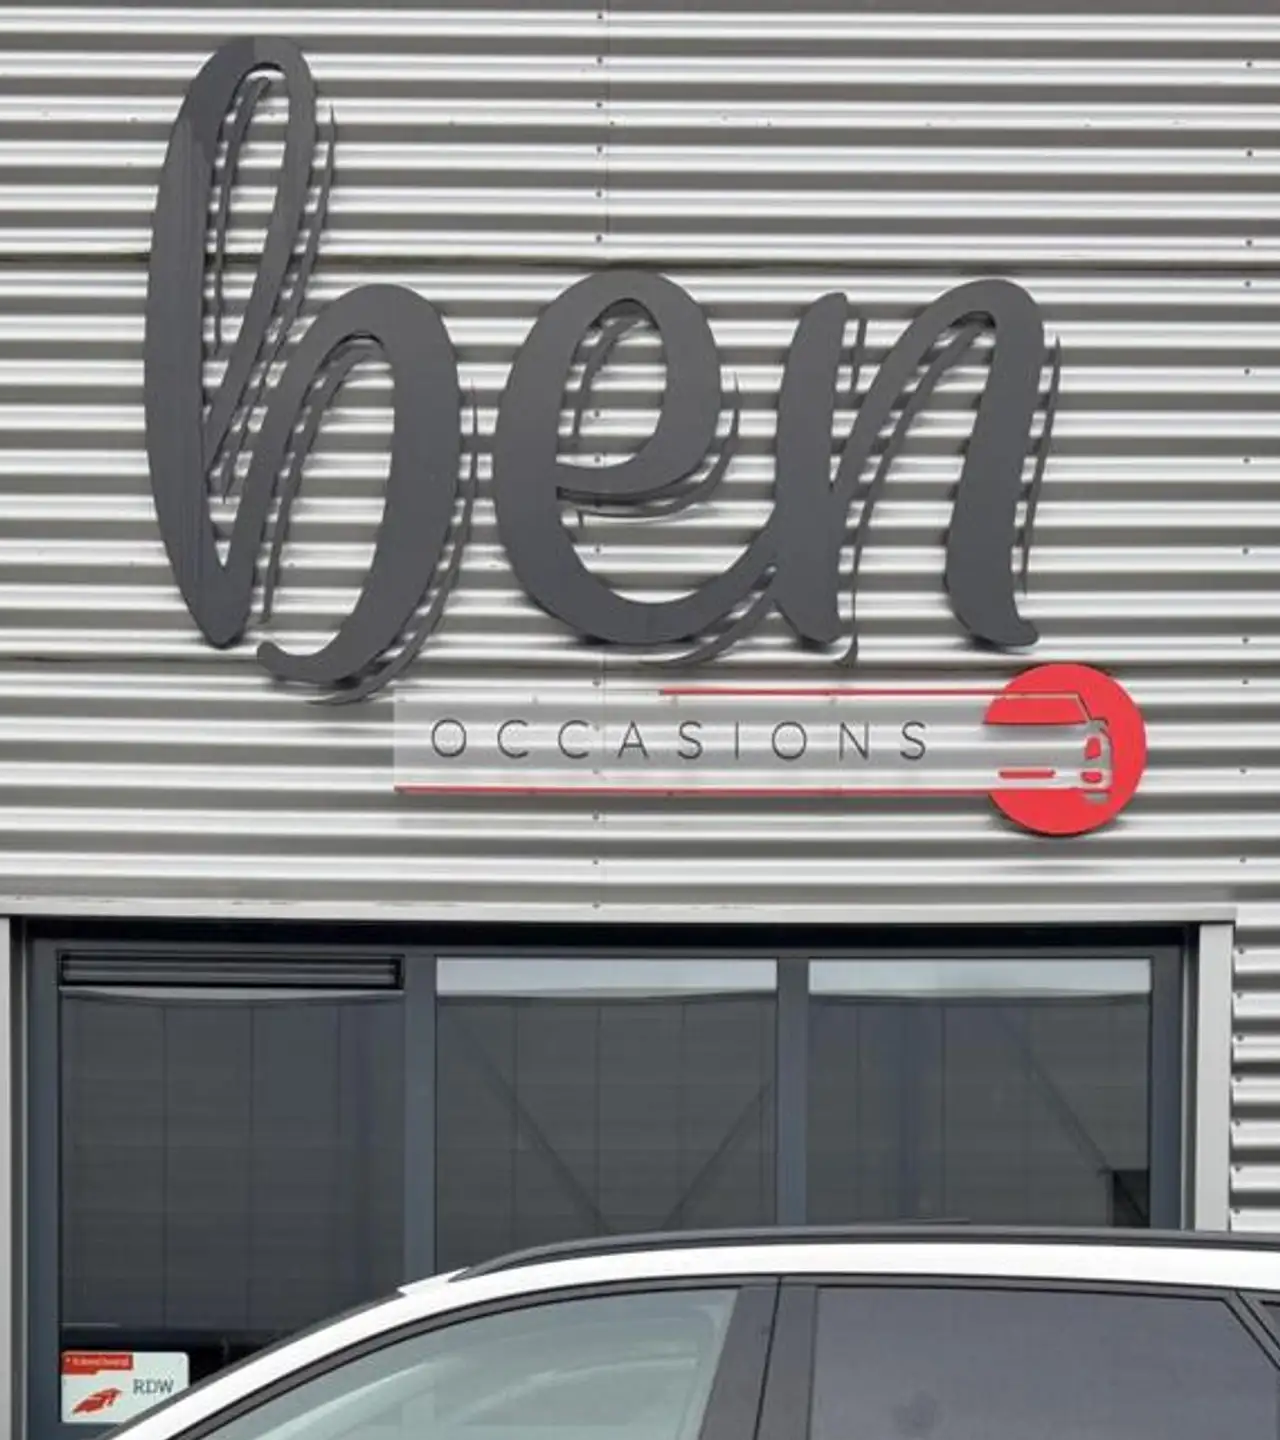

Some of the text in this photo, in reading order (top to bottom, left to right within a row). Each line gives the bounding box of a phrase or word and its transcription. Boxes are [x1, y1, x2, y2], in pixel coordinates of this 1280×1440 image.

[144, 36, 1039, 684] ben
[430, 718, 927, 761] OCCASIONS
[132, 1378, 174, 1394] RDW
